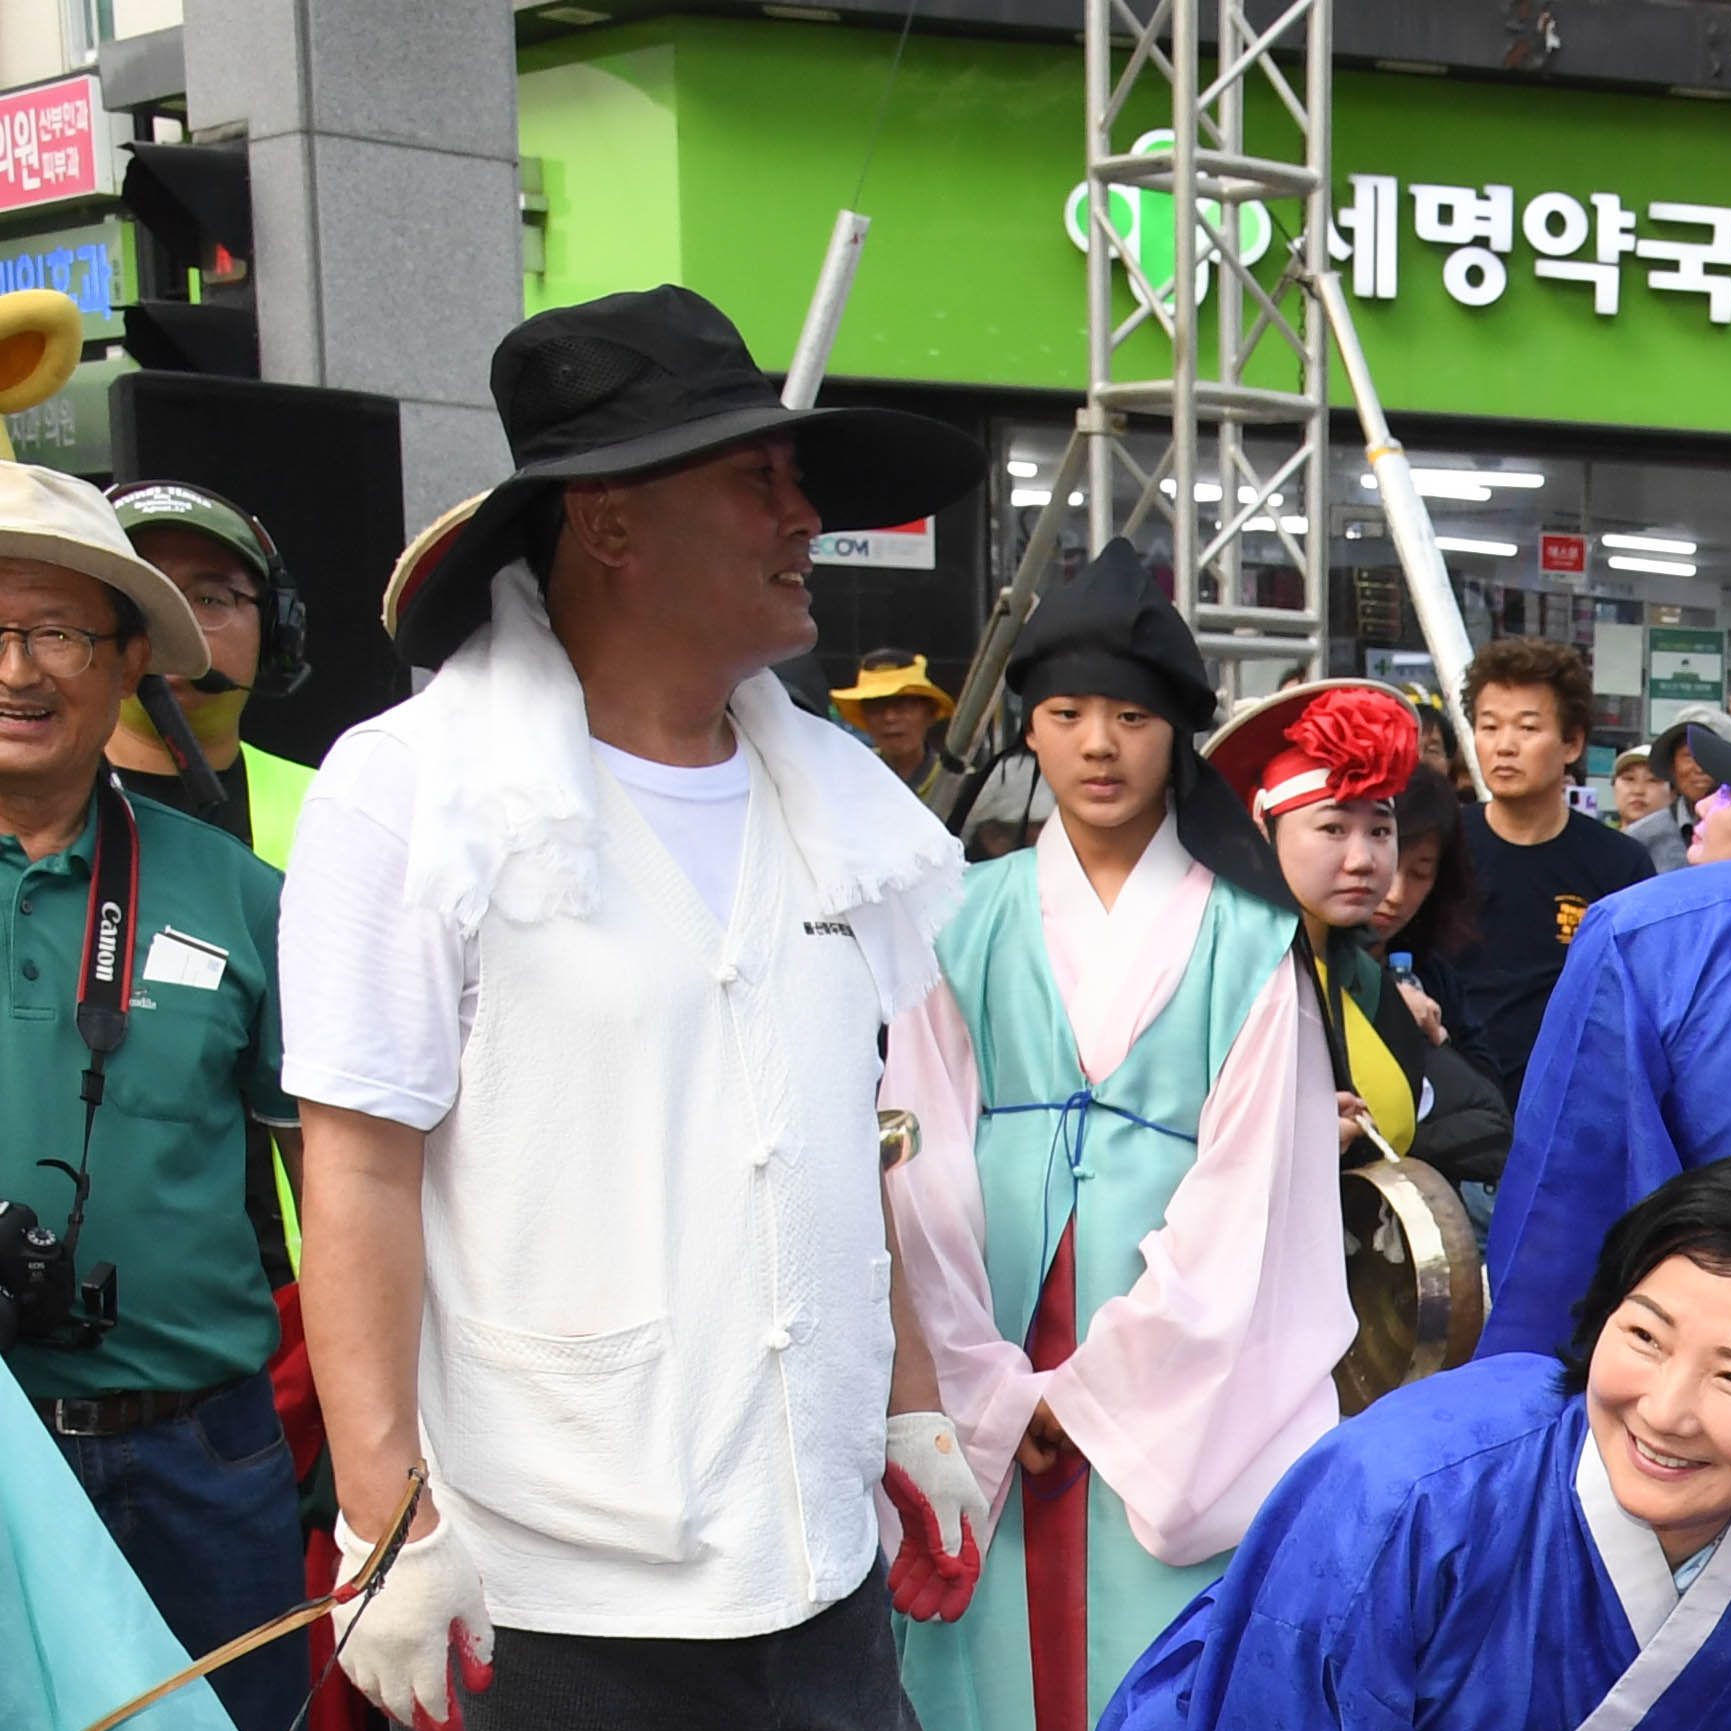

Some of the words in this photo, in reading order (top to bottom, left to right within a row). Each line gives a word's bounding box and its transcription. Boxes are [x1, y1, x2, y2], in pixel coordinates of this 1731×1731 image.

[39, 99, 88, 141] 산부인과
[42, 146, 80, 184] 피부과
[95, 901, 122, 982] Canon
